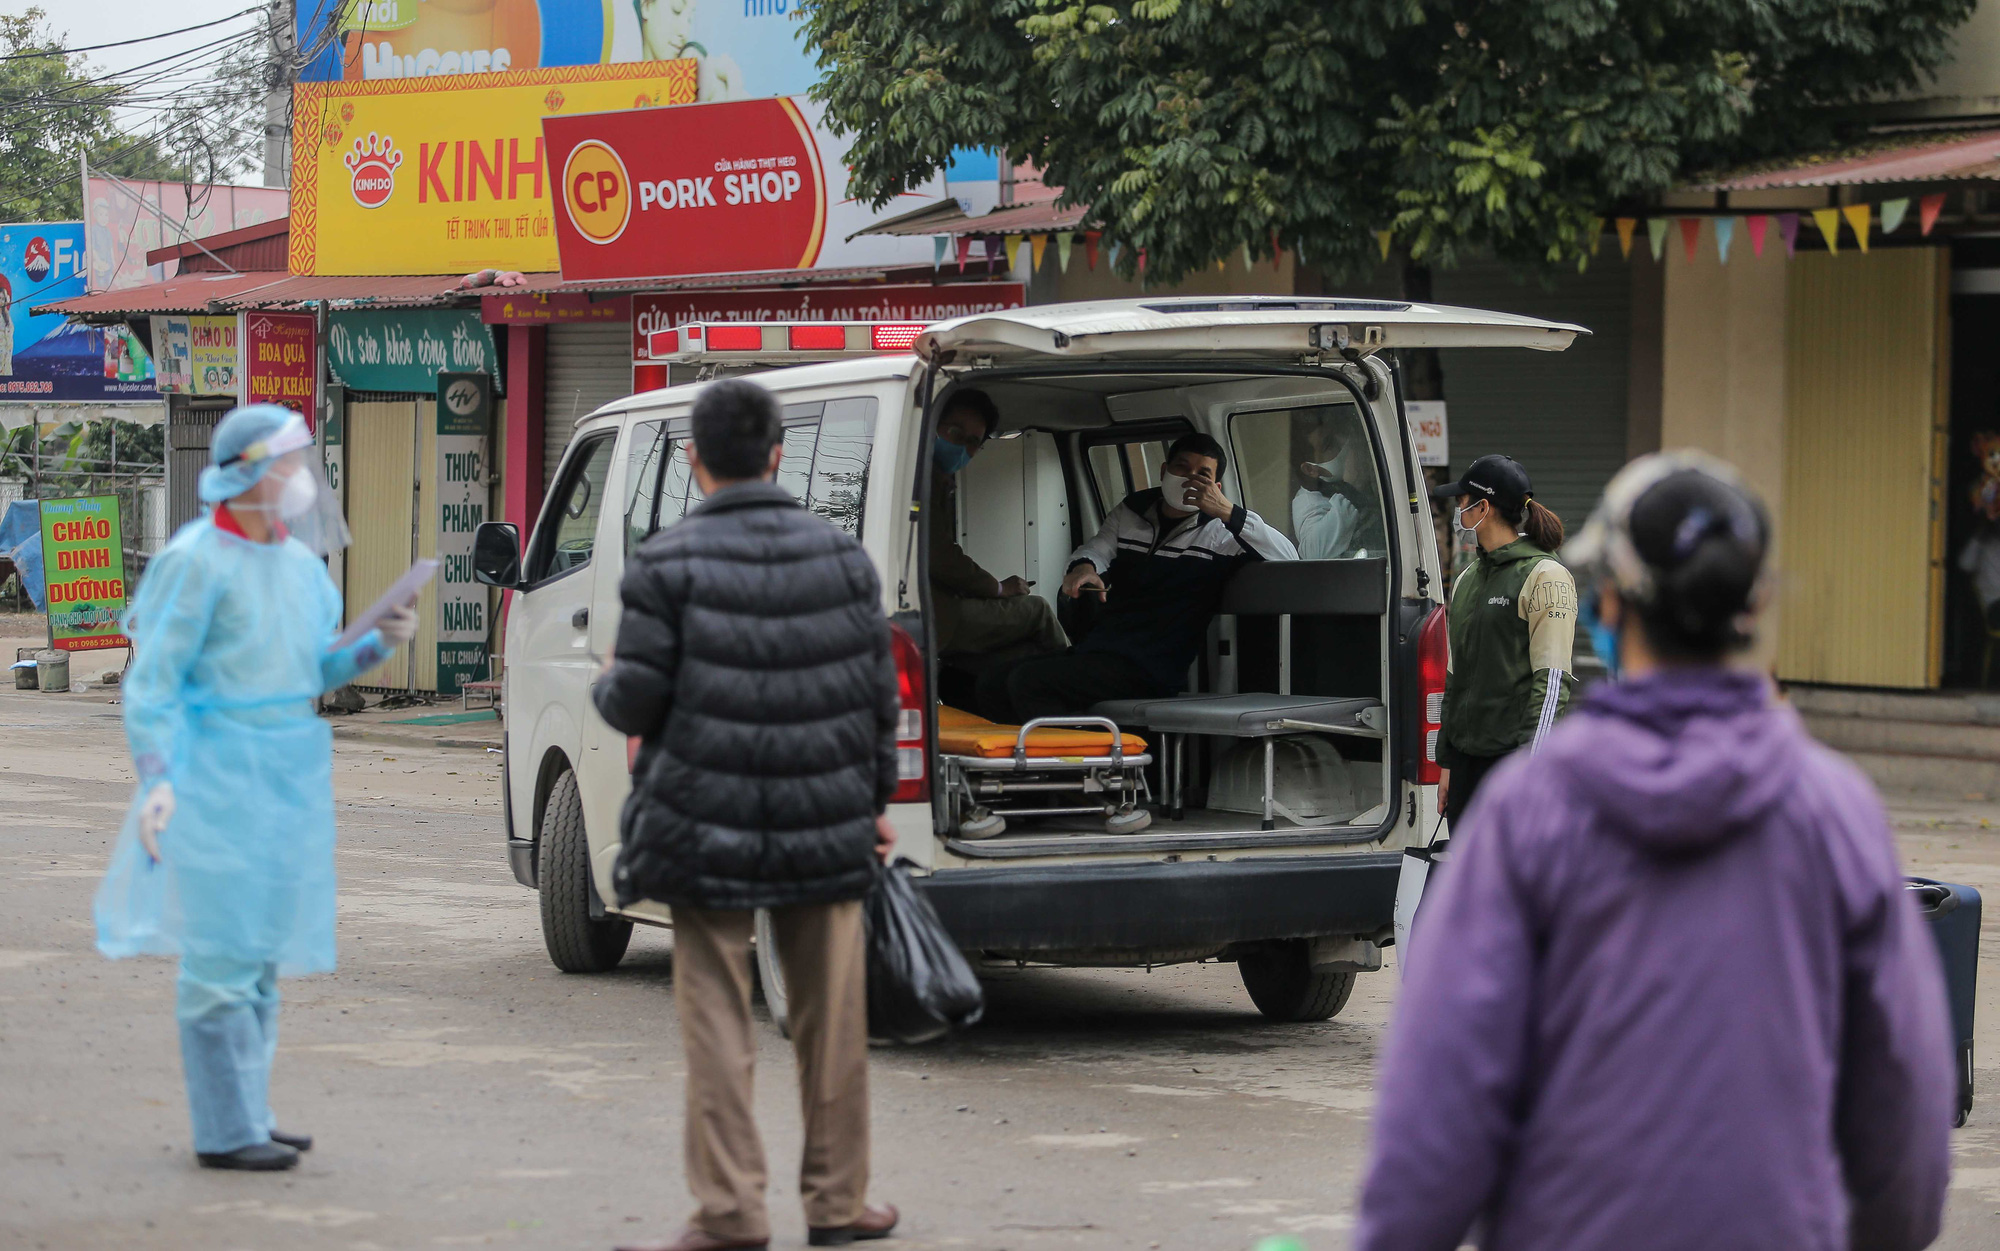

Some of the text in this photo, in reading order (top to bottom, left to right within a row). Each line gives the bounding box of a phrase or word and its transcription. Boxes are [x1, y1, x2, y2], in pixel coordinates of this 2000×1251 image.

[355, 177, 391, 191] KINH DO
[419, 137, 544, 203] KINH
[573, 171, 619, 213] CP
[638, 170, 801, 211] PORK SHOP
[224, 326, 238, 348] DI
[258, 342, 281, 362] HOA
[283, 336, 306, 367] QUẢ
[8, 381, 53, 393] 0975.032.768
[104, 382, 157, 393] www.fujicolor.com.v
[252, 366, 312, 400] NHẬP KHẨU
[445, 450, 480, 488] THỰC
[442, 492, 483, 533] PHẨM
[52, 516, 111, 543] CHÁO
[57, 547, 110, 571] DINH
[444, 546, 478, 584] CHỨ
[48, 575, 124, 603] DƯỠNG
[443, 596, 482, 631] NĂNG
[81, 639, 99, 648] 0985
[100, 638, 114, 646] 236
